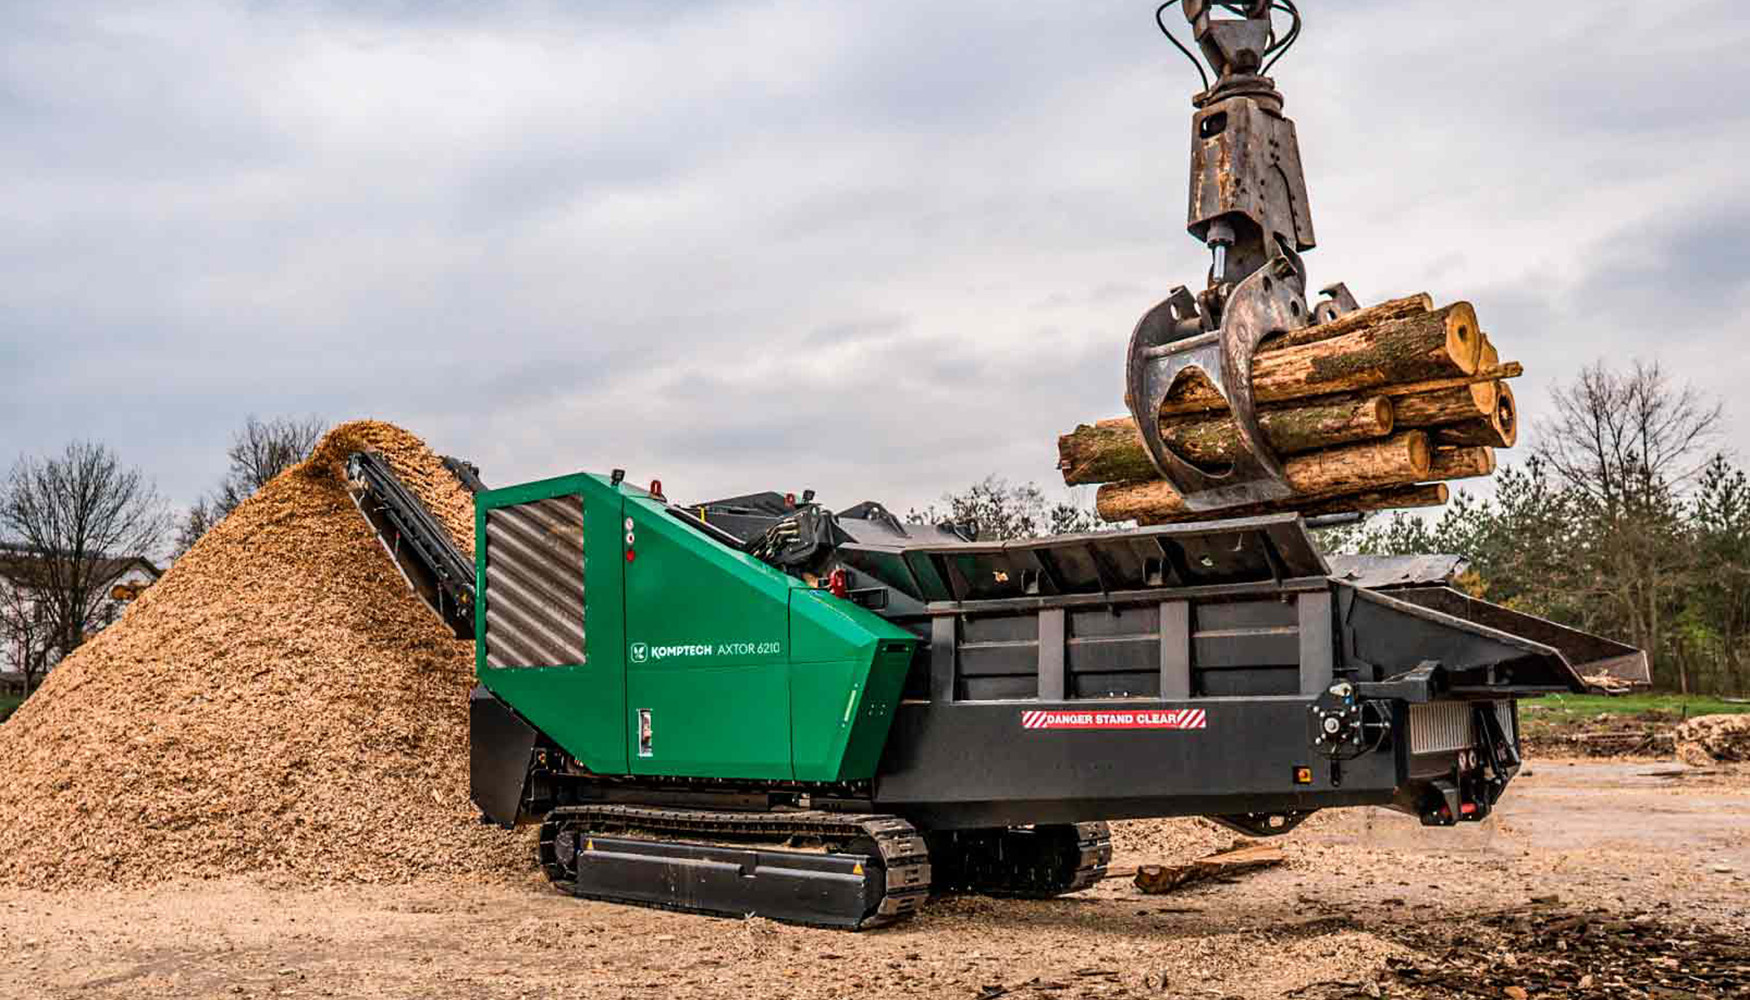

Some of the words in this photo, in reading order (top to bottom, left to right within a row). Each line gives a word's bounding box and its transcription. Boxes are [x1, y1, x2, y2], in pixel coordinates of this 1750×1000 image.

[651, 645, 713, 659] KOMPTECH
[717, 643, 756, 656] AXTOR
[757, 642, 780, 655] 6210
[1047, 714, 1092, 724] DANGER
[1095, 714, 1134, 724] STAND
[1137, 714, 1177, 724] CLEAR
